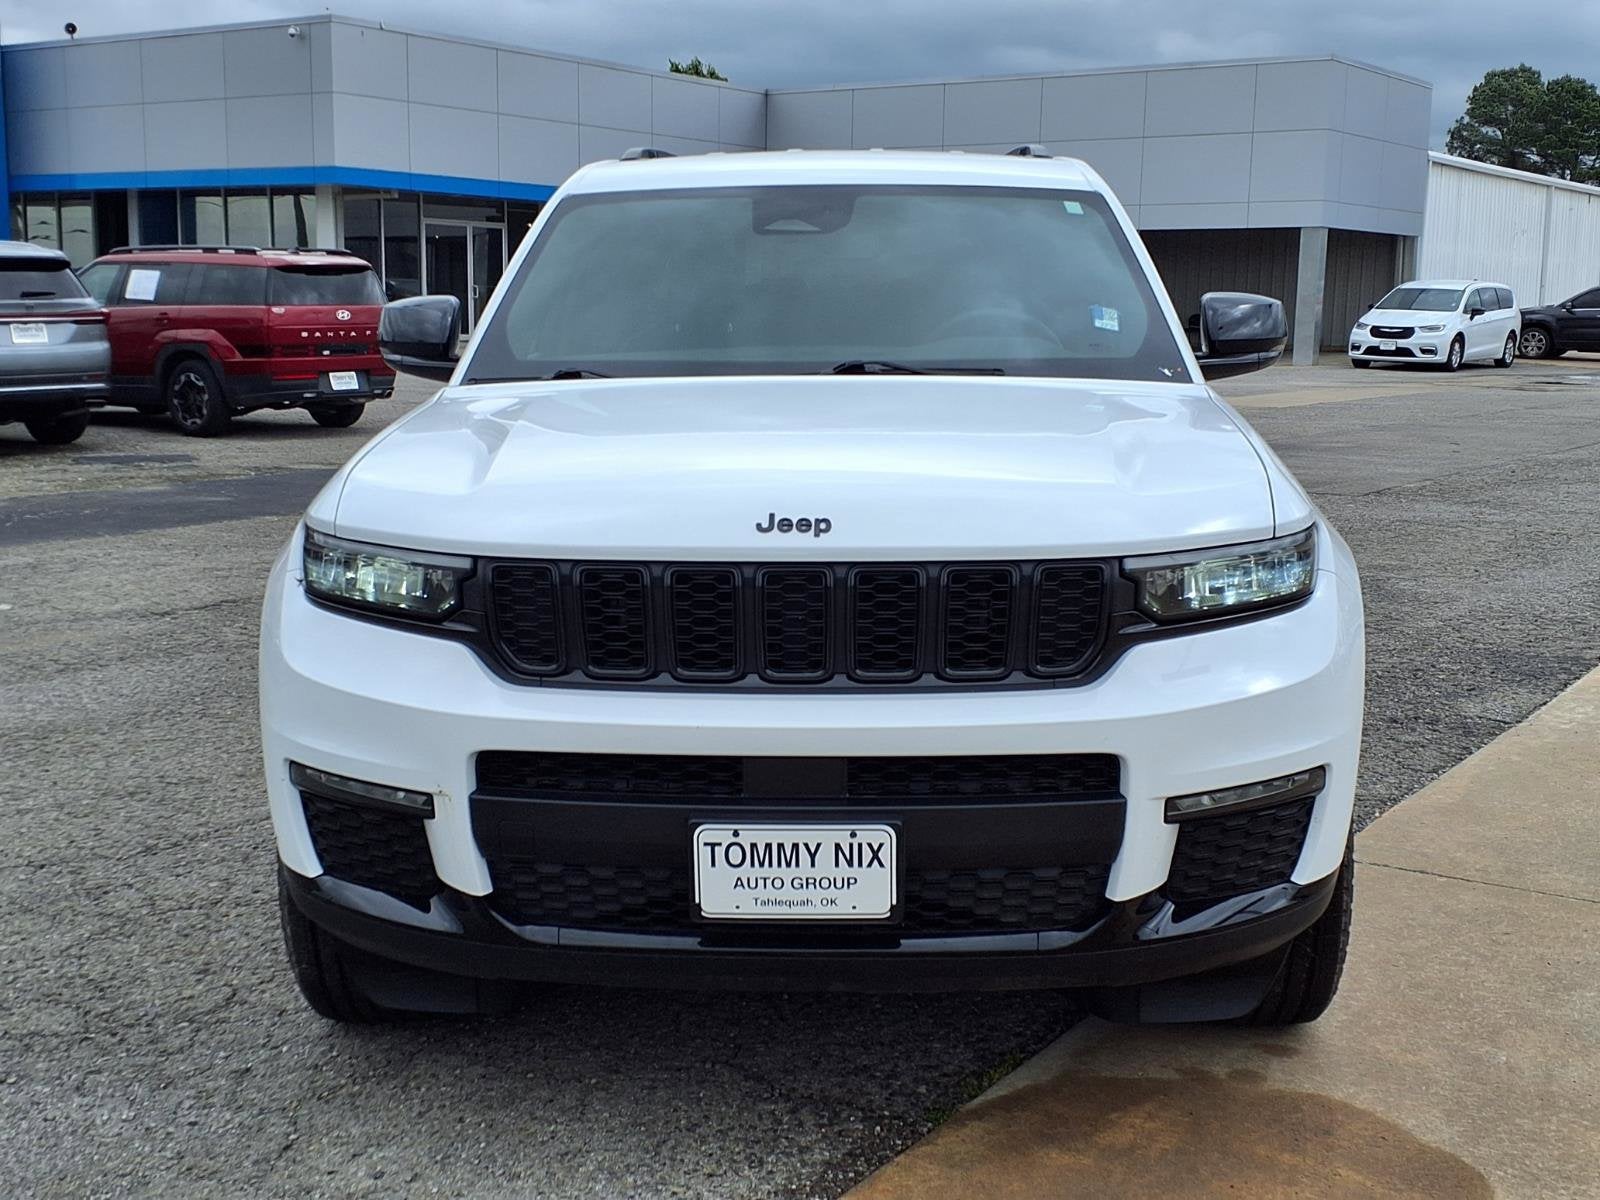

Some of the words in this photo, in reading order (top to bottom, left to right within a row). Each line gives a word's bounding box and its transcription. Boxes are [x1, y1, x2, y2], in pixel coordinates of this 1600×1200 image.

[756, 512, 832, 538] Jeep
[703, 842, 822, 869] TOMMY
[834, 842, 886, 868] NIX
[733, 876, 784, 890] AUTO
[790, 876, 858, 890] GROUP
[752, 898, 817, 908] Tahlequah,
[820, 898, 838, 907] OK
